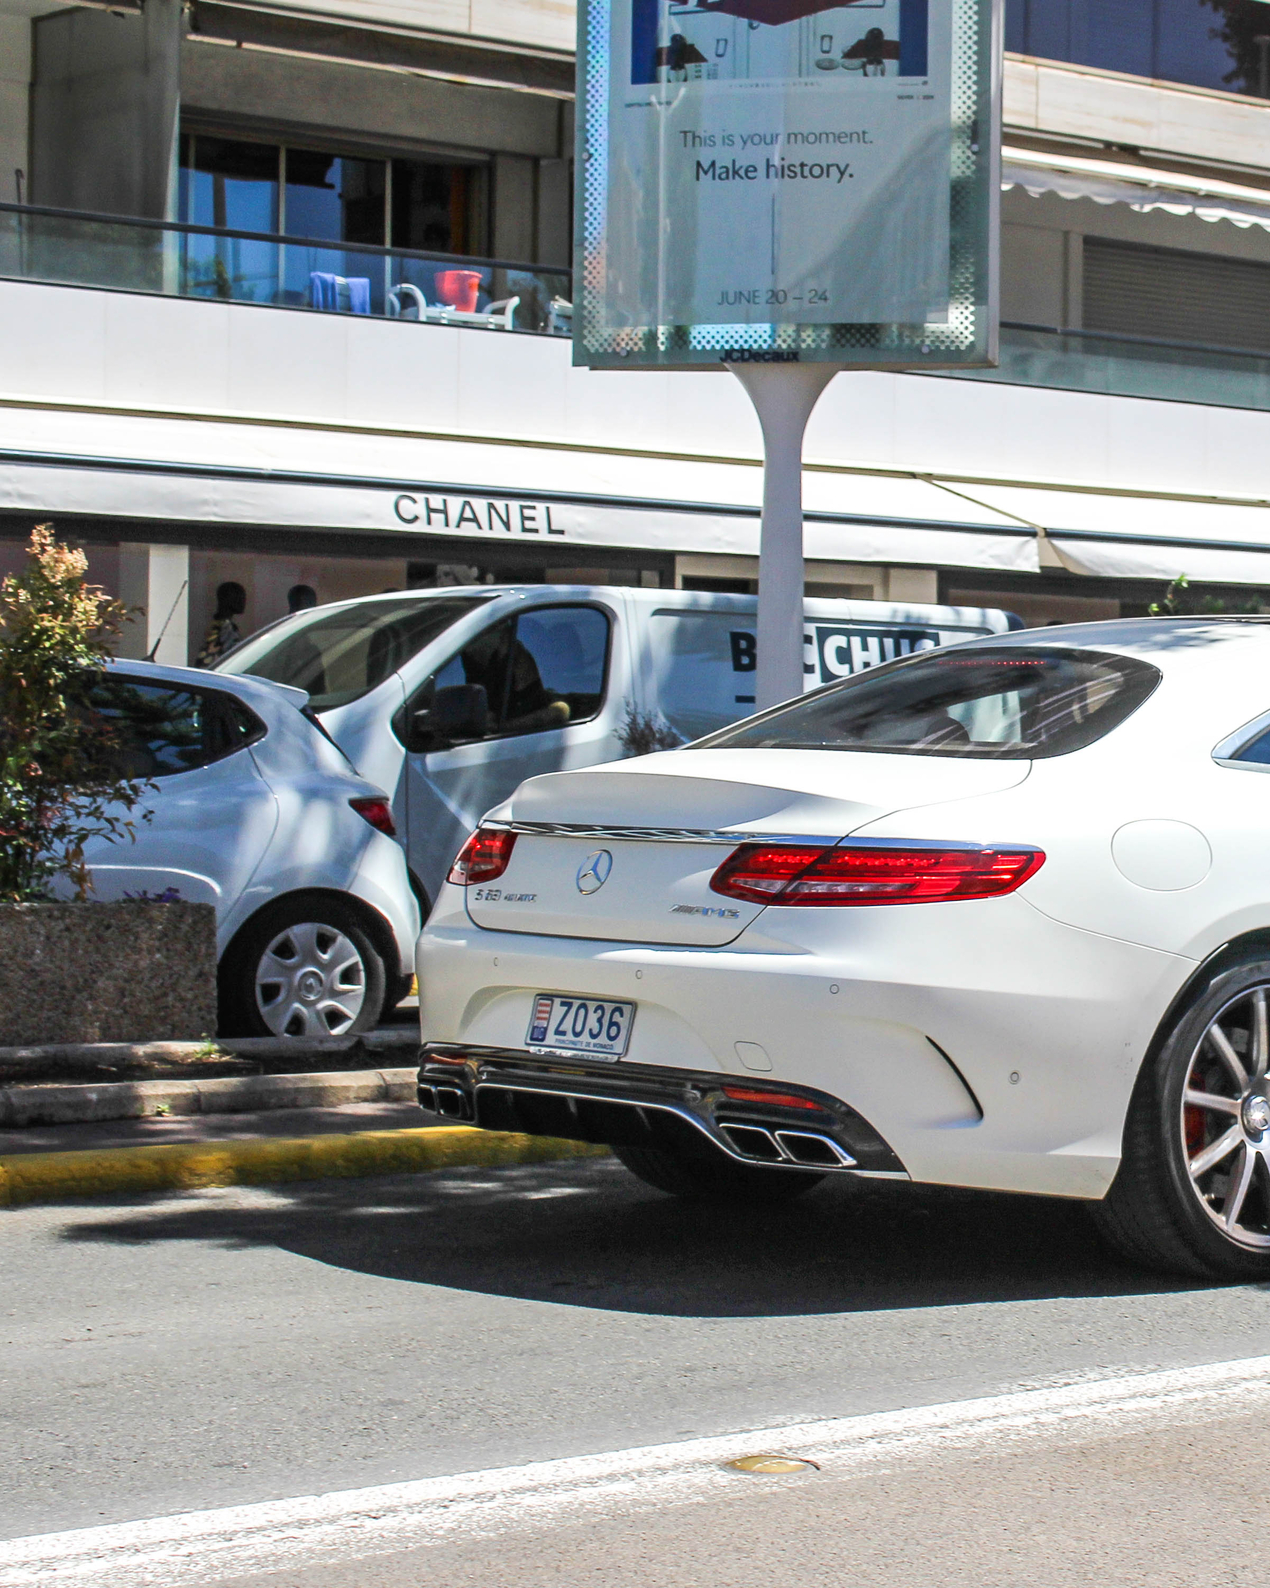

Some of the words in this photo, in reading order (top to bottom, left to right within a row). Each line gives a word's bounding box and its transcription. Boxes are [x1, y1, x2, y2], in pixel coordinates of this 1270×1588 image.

[679, 130, 716, 148] This
[721, 129, 735, 147] is
[740, 132, 780, 150] your
[786, 128, 873, 146] moment.
[696, 158, 758, 182] Make
[765, 157, 854, 184] history.
[717, 289, 760, 306] JUNE
[765, 289, 788, 305] 20
[808, 288, 829, 305] 24
[719, 348, 799, 363] JCDecaux
[393, 494, 566, 536] CHANEL
[554, 1000, 625, 1042] Z036
